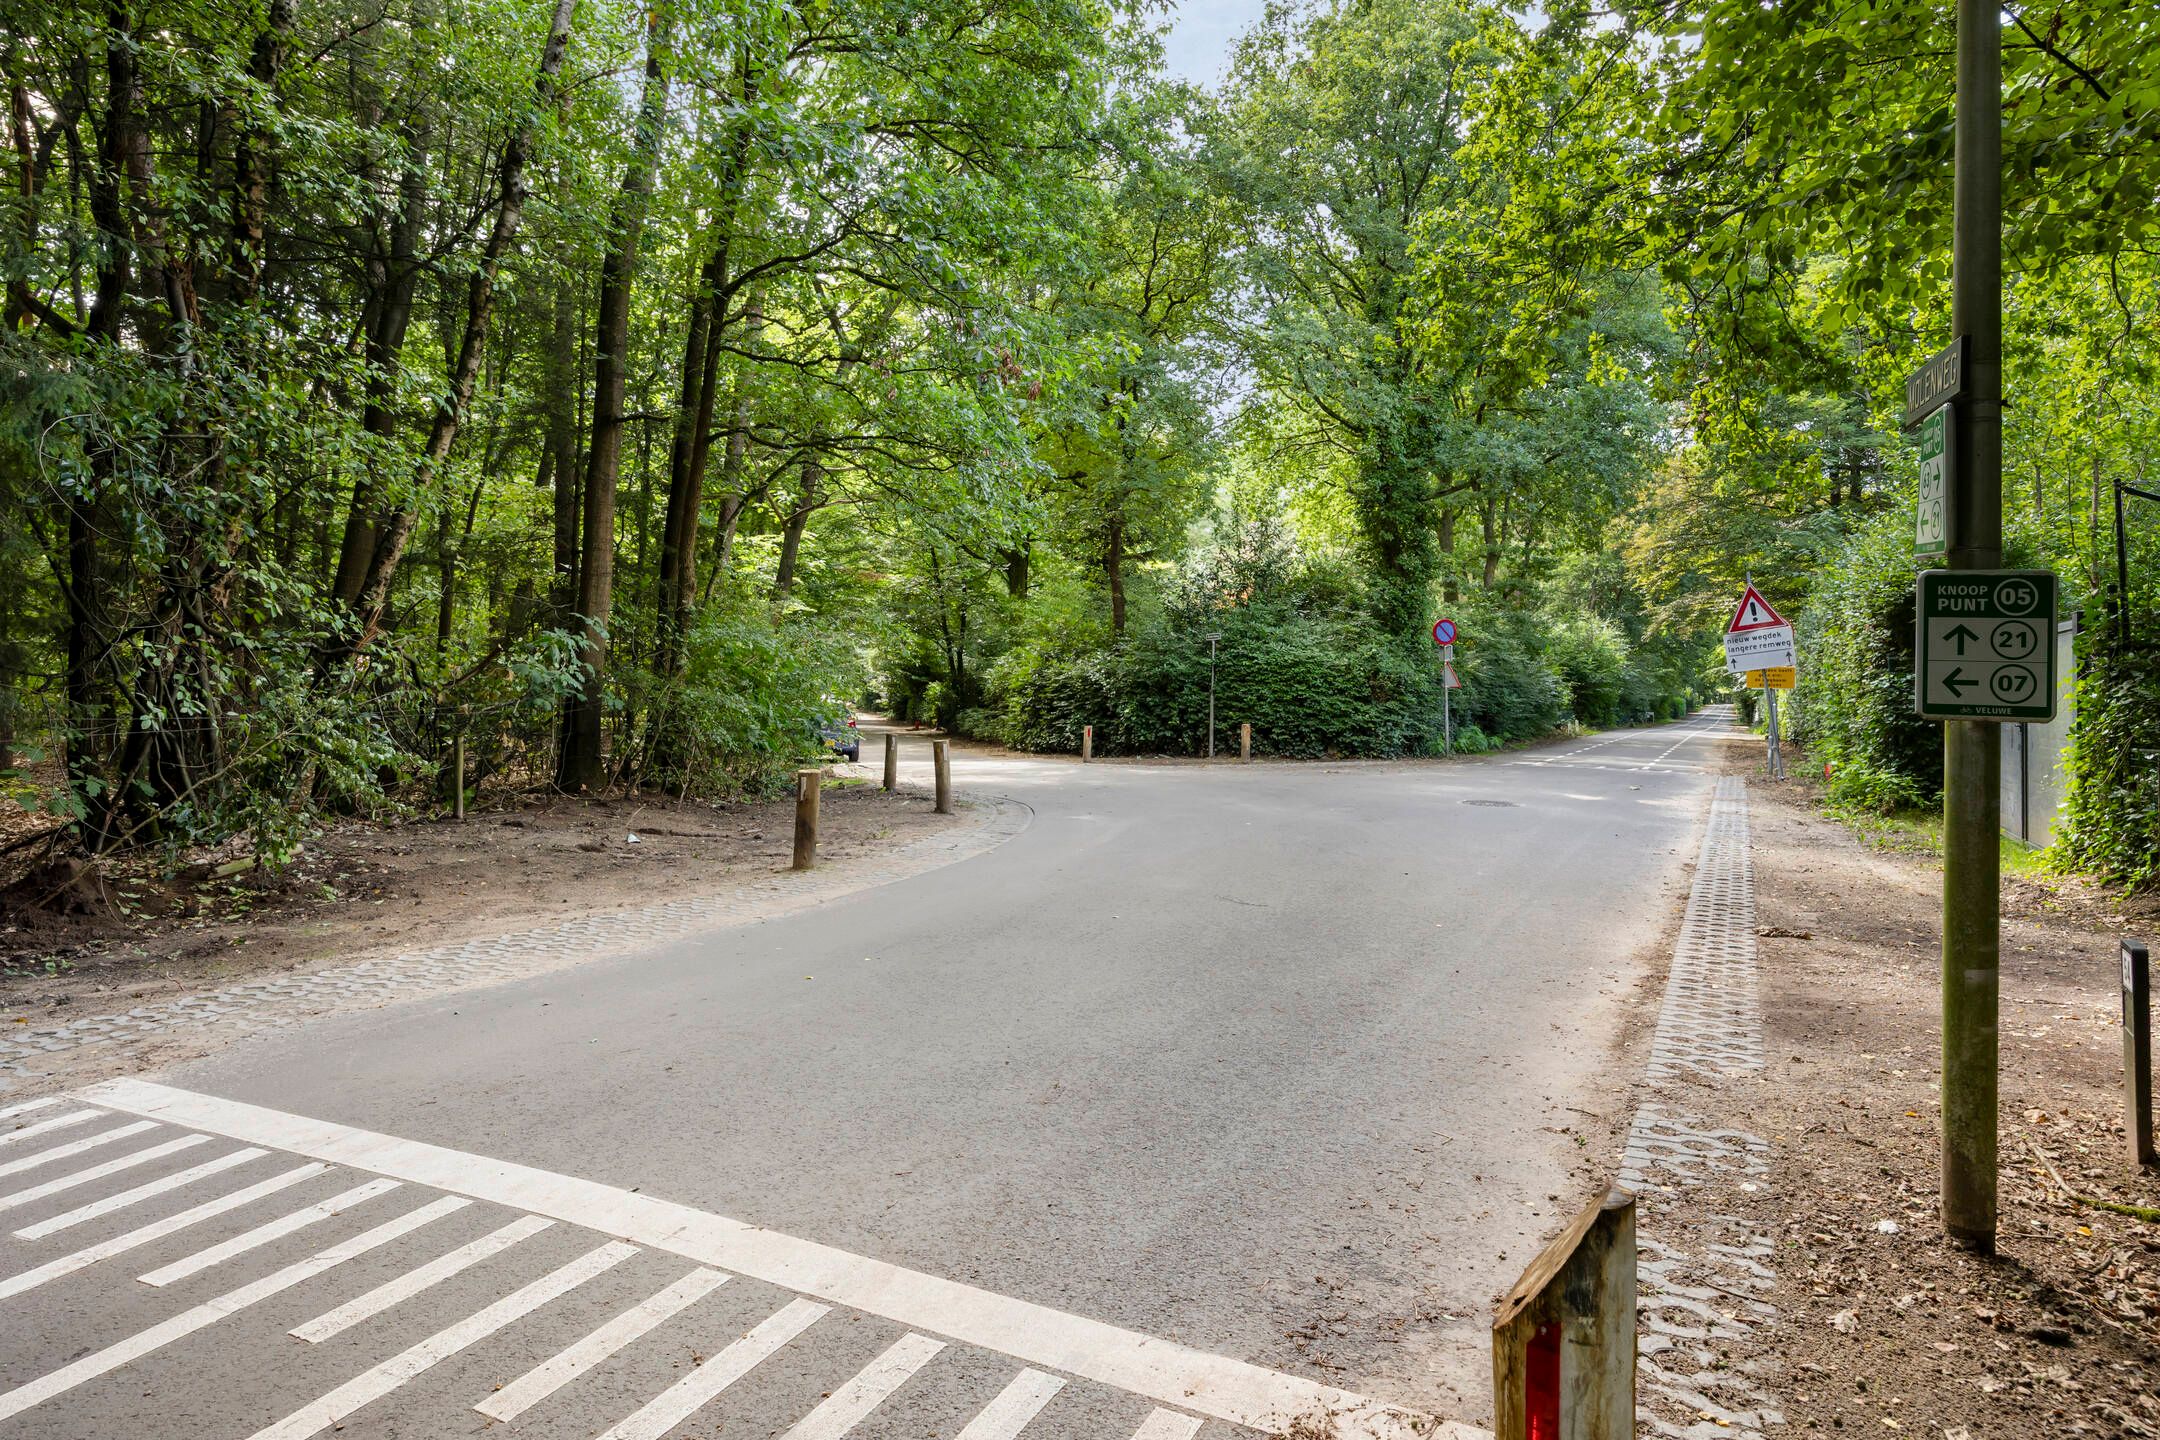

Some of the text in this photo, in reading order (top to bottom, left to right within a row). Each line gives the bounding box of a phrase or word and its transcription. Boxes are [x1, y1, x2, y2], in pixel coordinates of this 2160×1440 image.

[1908, 352, 1958, 413] MOLENWEG
[1932, 511, 1940, 528] 21
[1937, 585, 1989, 596] KNOOP
[2000, 588, 2031, 605] 05
[1937, 598, 1989, 611] PUNT
[1727, 631, 1782, 644] nieuw wegdek
[1998, 631, 2027, 648] 21
[1727, 640, 1791, 653] langere remweg
[1998, 675, 2028, 692] 07
[1975, 707, 2012, 715] VELUWE
